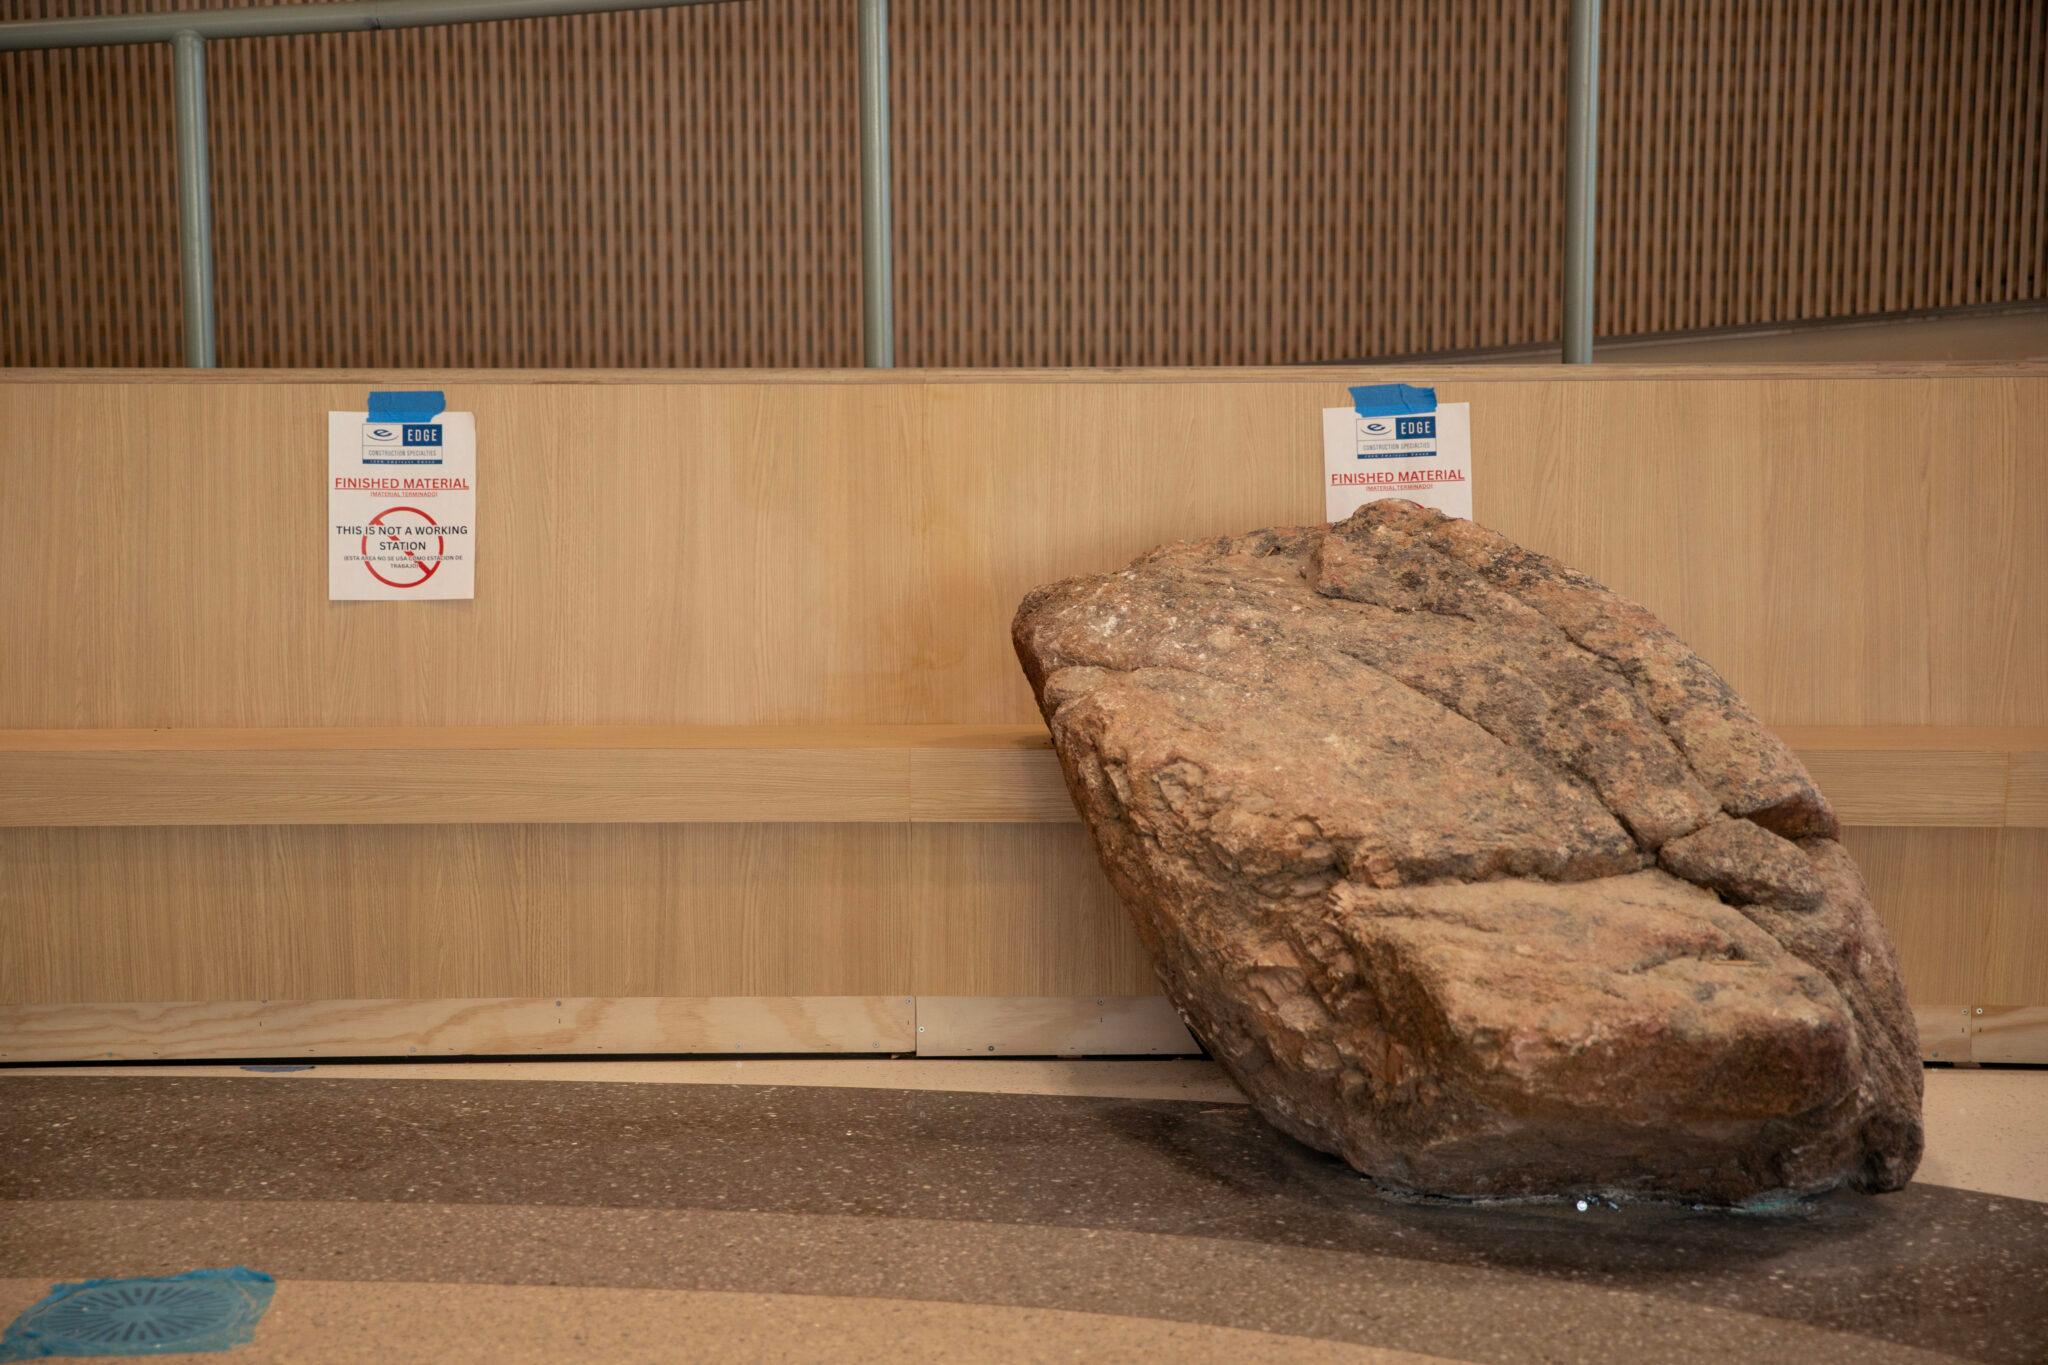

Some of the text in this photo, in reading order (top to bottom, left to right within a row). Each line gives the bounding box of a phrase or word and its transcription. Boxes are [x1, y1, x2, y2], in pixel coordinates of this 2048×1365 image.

[1401, 422, 1430, 434] EDGE
[408, 430, 437, 442] EDGE
[1331, 469, 1465, 484] FINISHED MATERIAL
[335, 478, 470, 489] FINISHED MATERIAL
[336, 526, 468, 535] THIS IS NOT A WORKING
[380, 542, 426, 550] STATION
